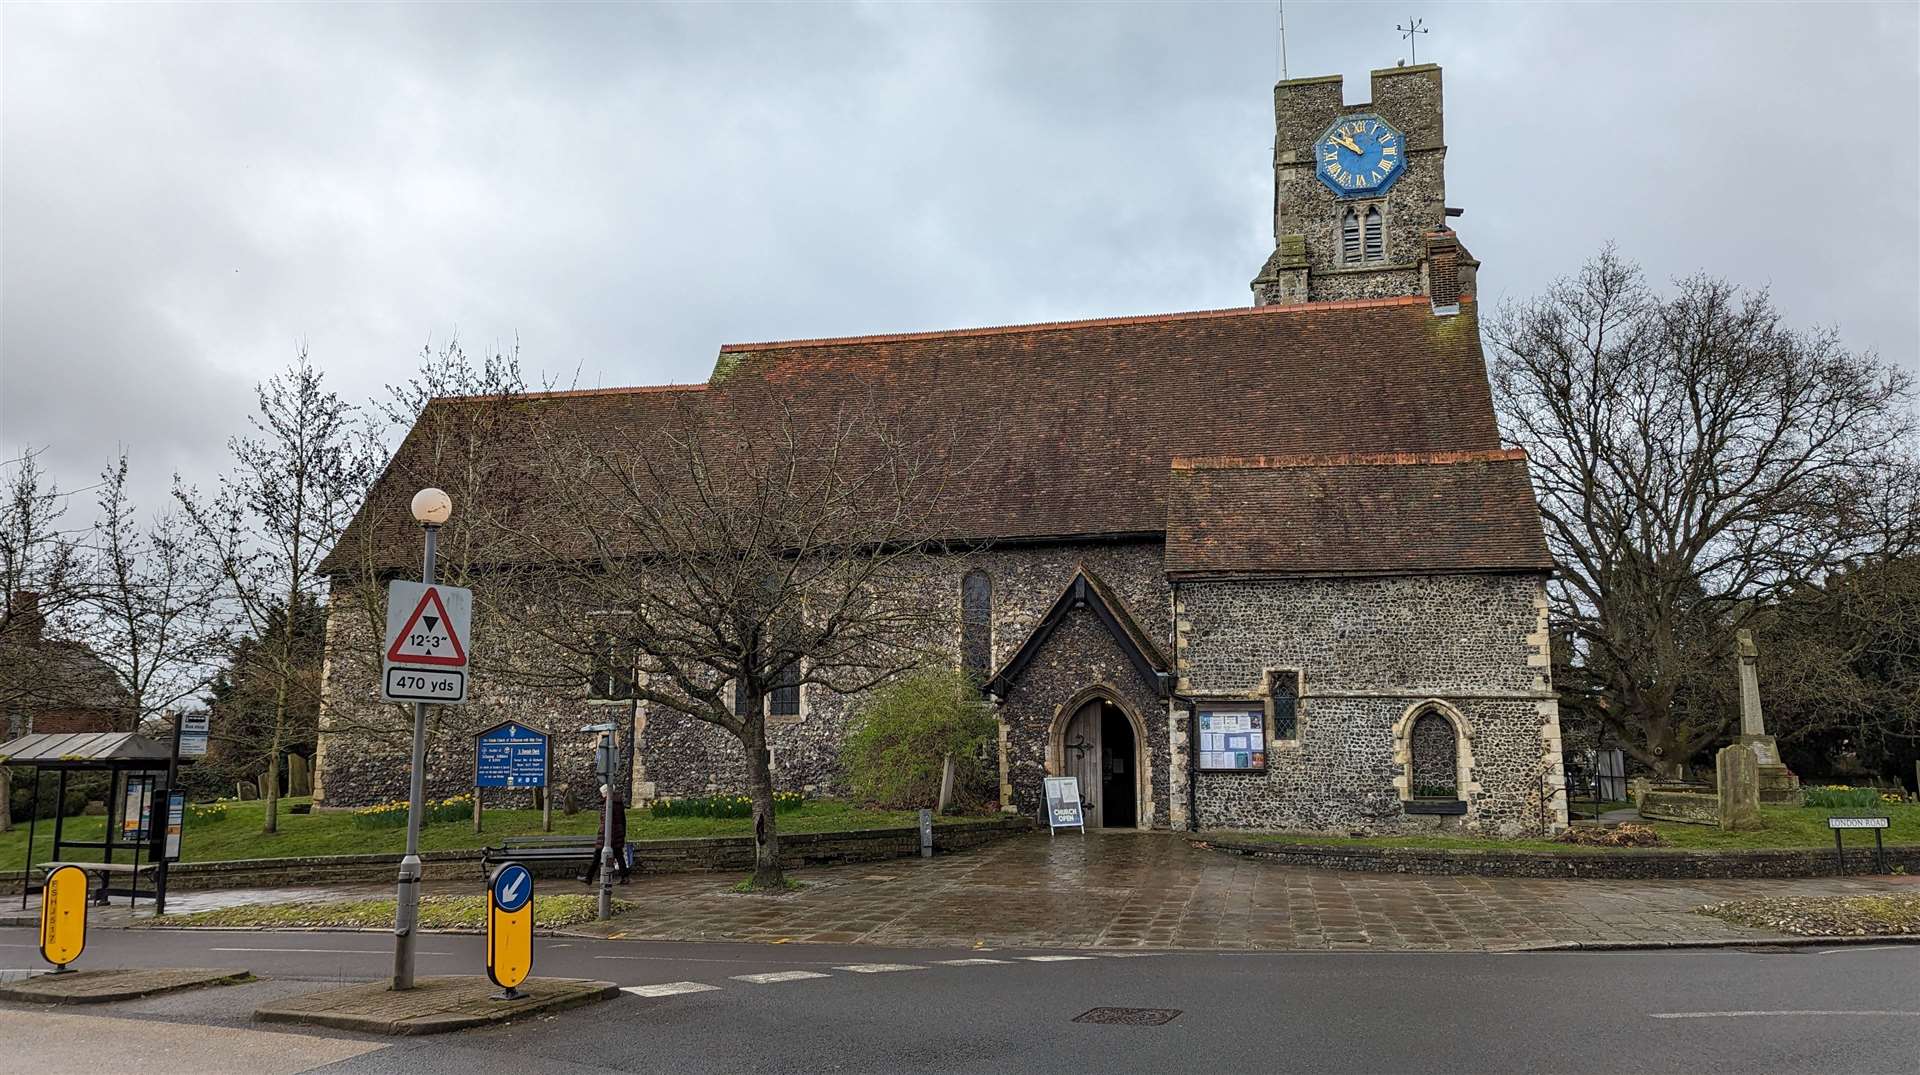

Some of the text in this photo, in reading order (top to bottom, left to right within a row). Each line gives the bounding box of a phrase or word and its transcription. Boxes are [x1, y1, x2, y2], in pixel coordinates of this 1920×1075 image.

[1355, 174, 1367, 186] VI
[1371, 170, 1383, 183] V
[396, 676, 454, 693] 470 yds
[1831, 819, 1886, 827] LONDON ROAD
